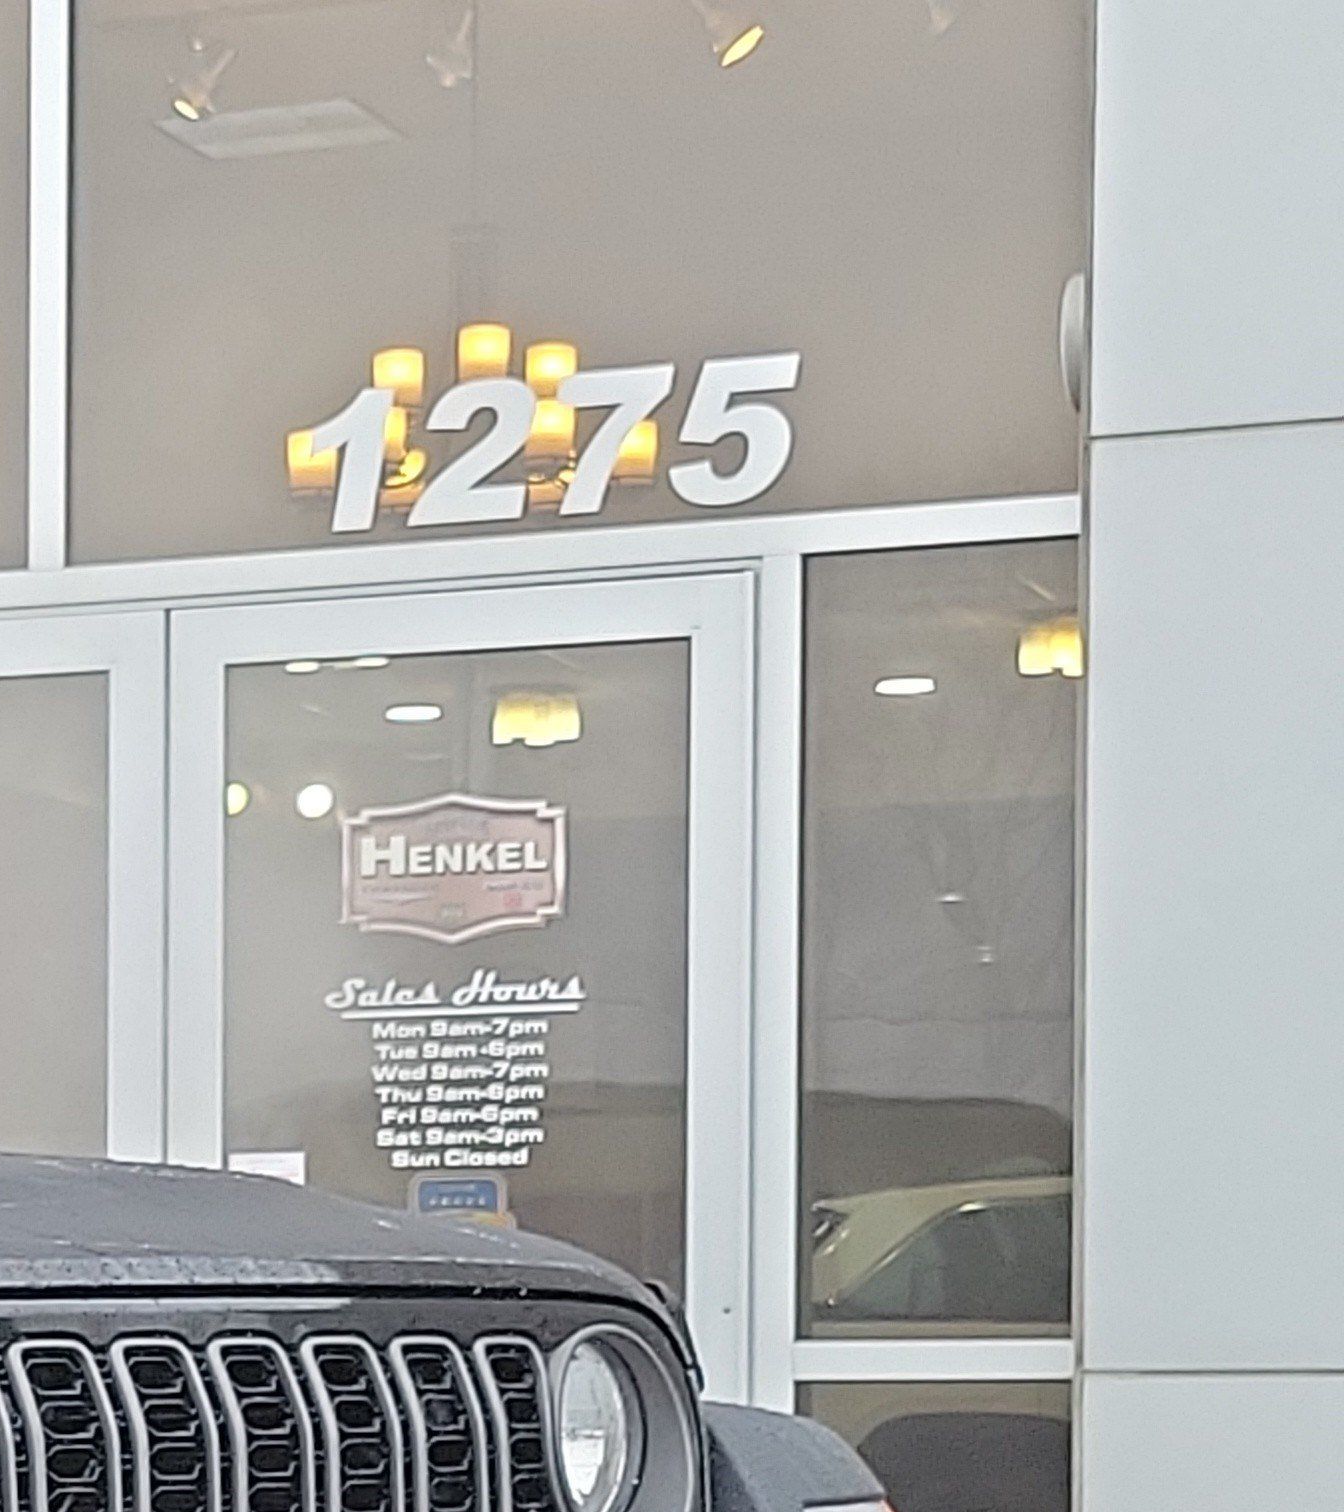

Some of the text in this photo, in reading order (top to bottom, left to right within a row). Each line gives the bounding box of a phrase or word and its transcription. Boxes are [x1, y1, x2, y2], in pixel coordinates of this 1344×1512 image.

[312, 352, 802, 534] 1275
[360, 834, 549, 878] HENKEL
[323, 968, 587, 1009] Sales Hours
[371, 1022, 426, 1040] Mon
[373, 1042, 419, 1060] Tue
[370, 1062, 429, 1082] Wed
[374, 1085, 423, 1103] Thu
[381, 1106, 417, 1125] Fri
[375, 1127, 422, 1147] Sat
[390, 1146, 530, 1168] Sun Closed
